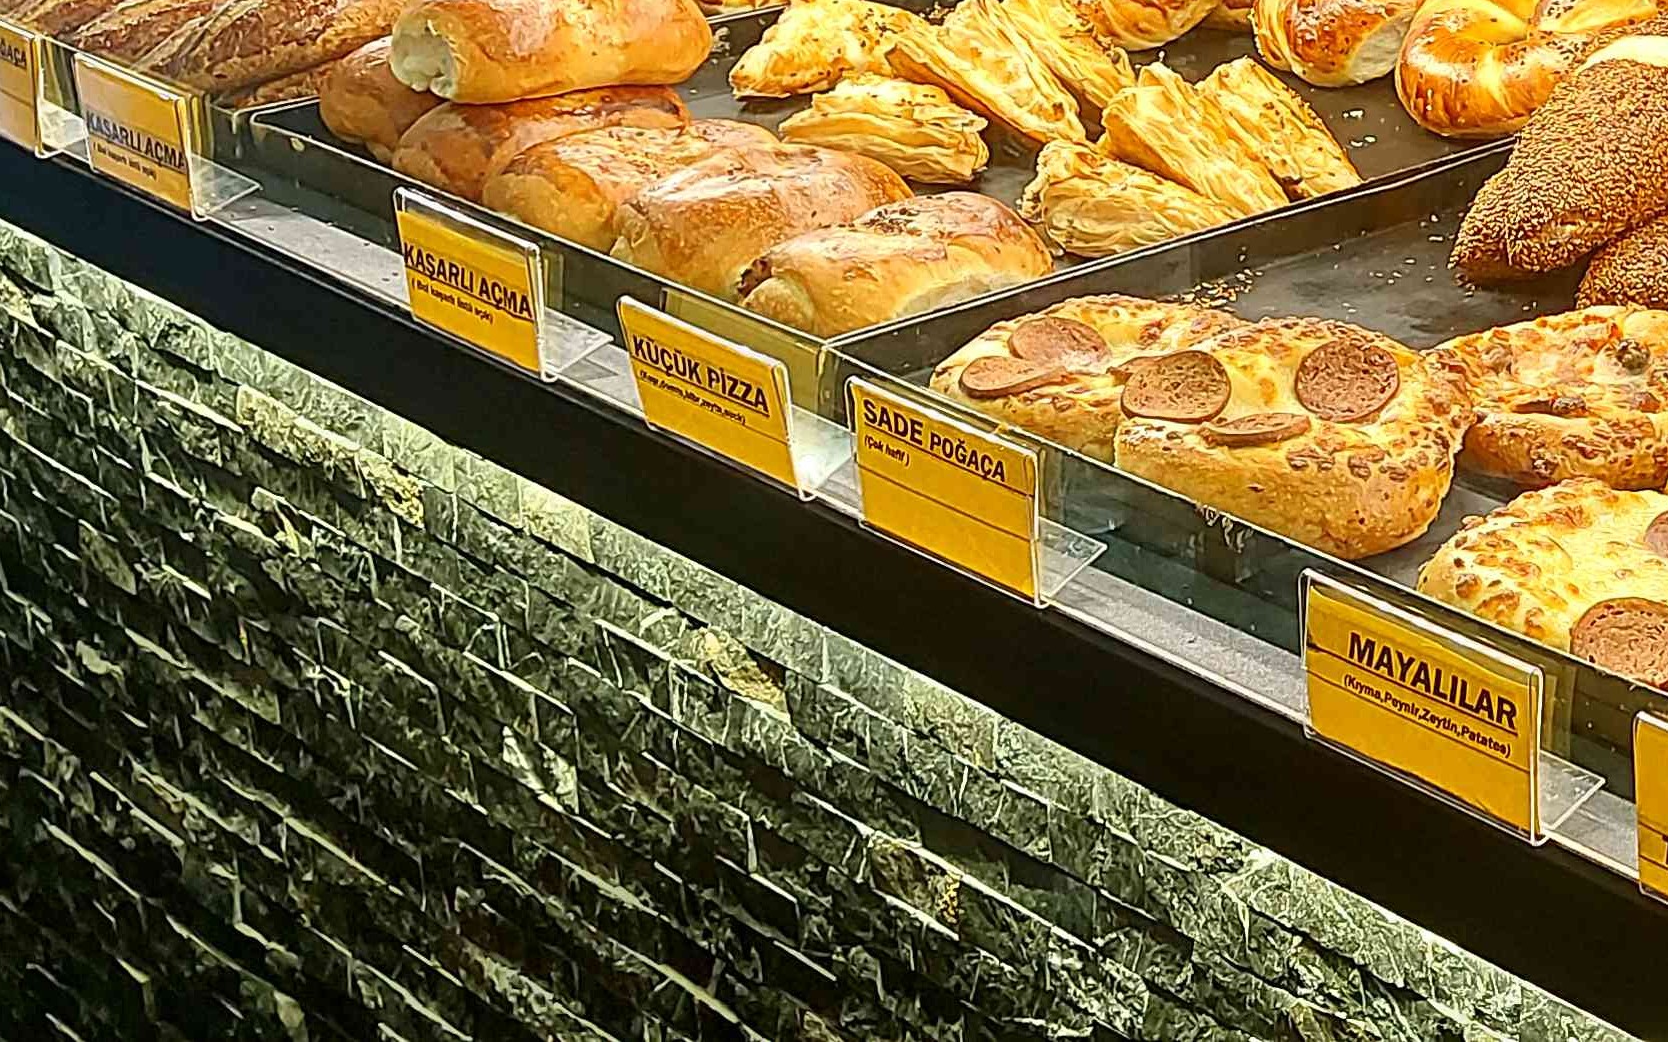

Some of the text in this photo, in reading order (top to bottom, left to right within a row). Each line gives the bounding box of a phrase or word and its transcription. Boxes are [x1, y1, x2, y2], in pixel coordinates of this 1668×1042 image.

[145, 136, 187, 169] AÇMA
[402, 242, 474, 294] KAŞARLI
[478, 277, 533, 320] AÇMA
[632, 333, 702, 385] KÜÇÜK
[707, 366, 770, 414] PİZZA
[863, 399, 1006, 483] SADE POĞAÇA
[1348, 631, 1518, 731] MAYALILAR
